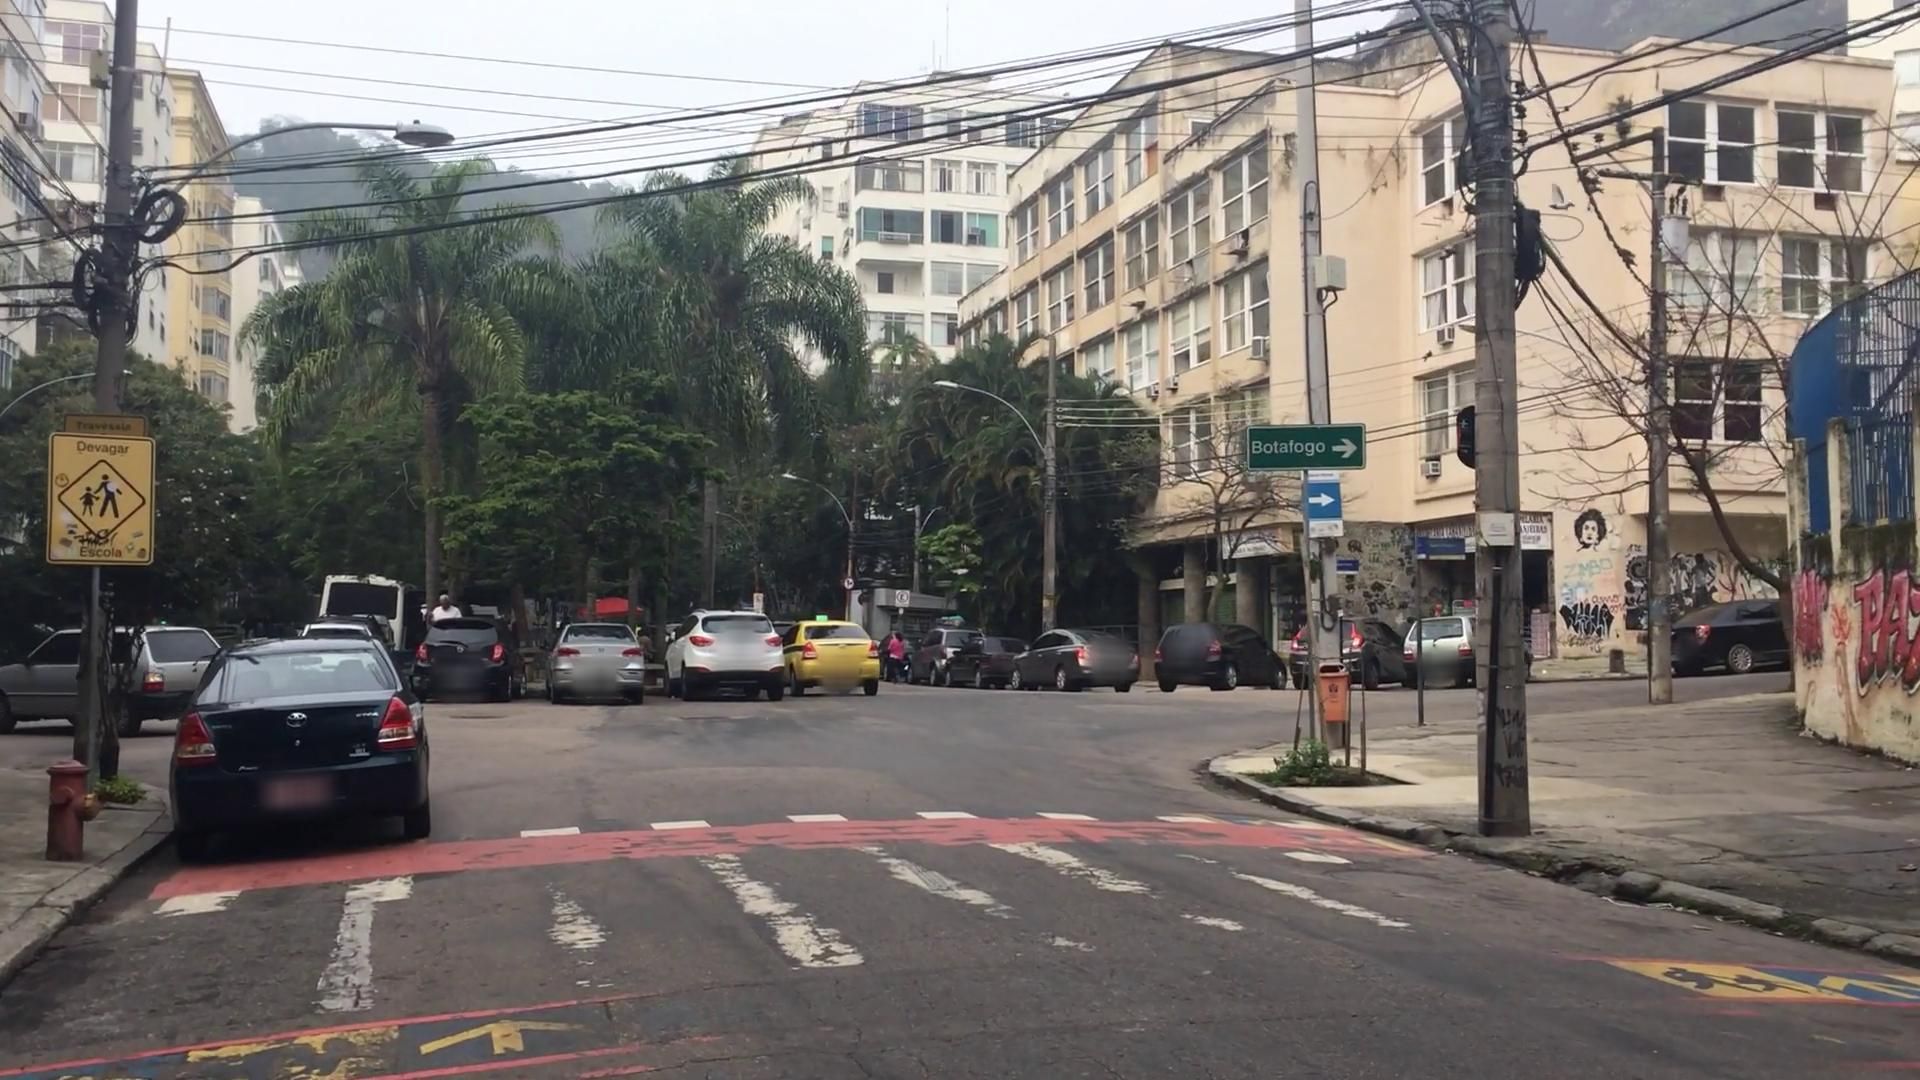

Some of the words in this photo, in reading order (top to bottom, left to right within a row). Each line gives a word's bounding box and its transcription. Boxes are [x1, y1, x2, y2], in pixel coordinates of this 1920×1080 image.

[77, 440, 130, 455] Devagar
[1251, 440, 1326, 456] Botafogo
[79, 546, 123, 558] Escola
